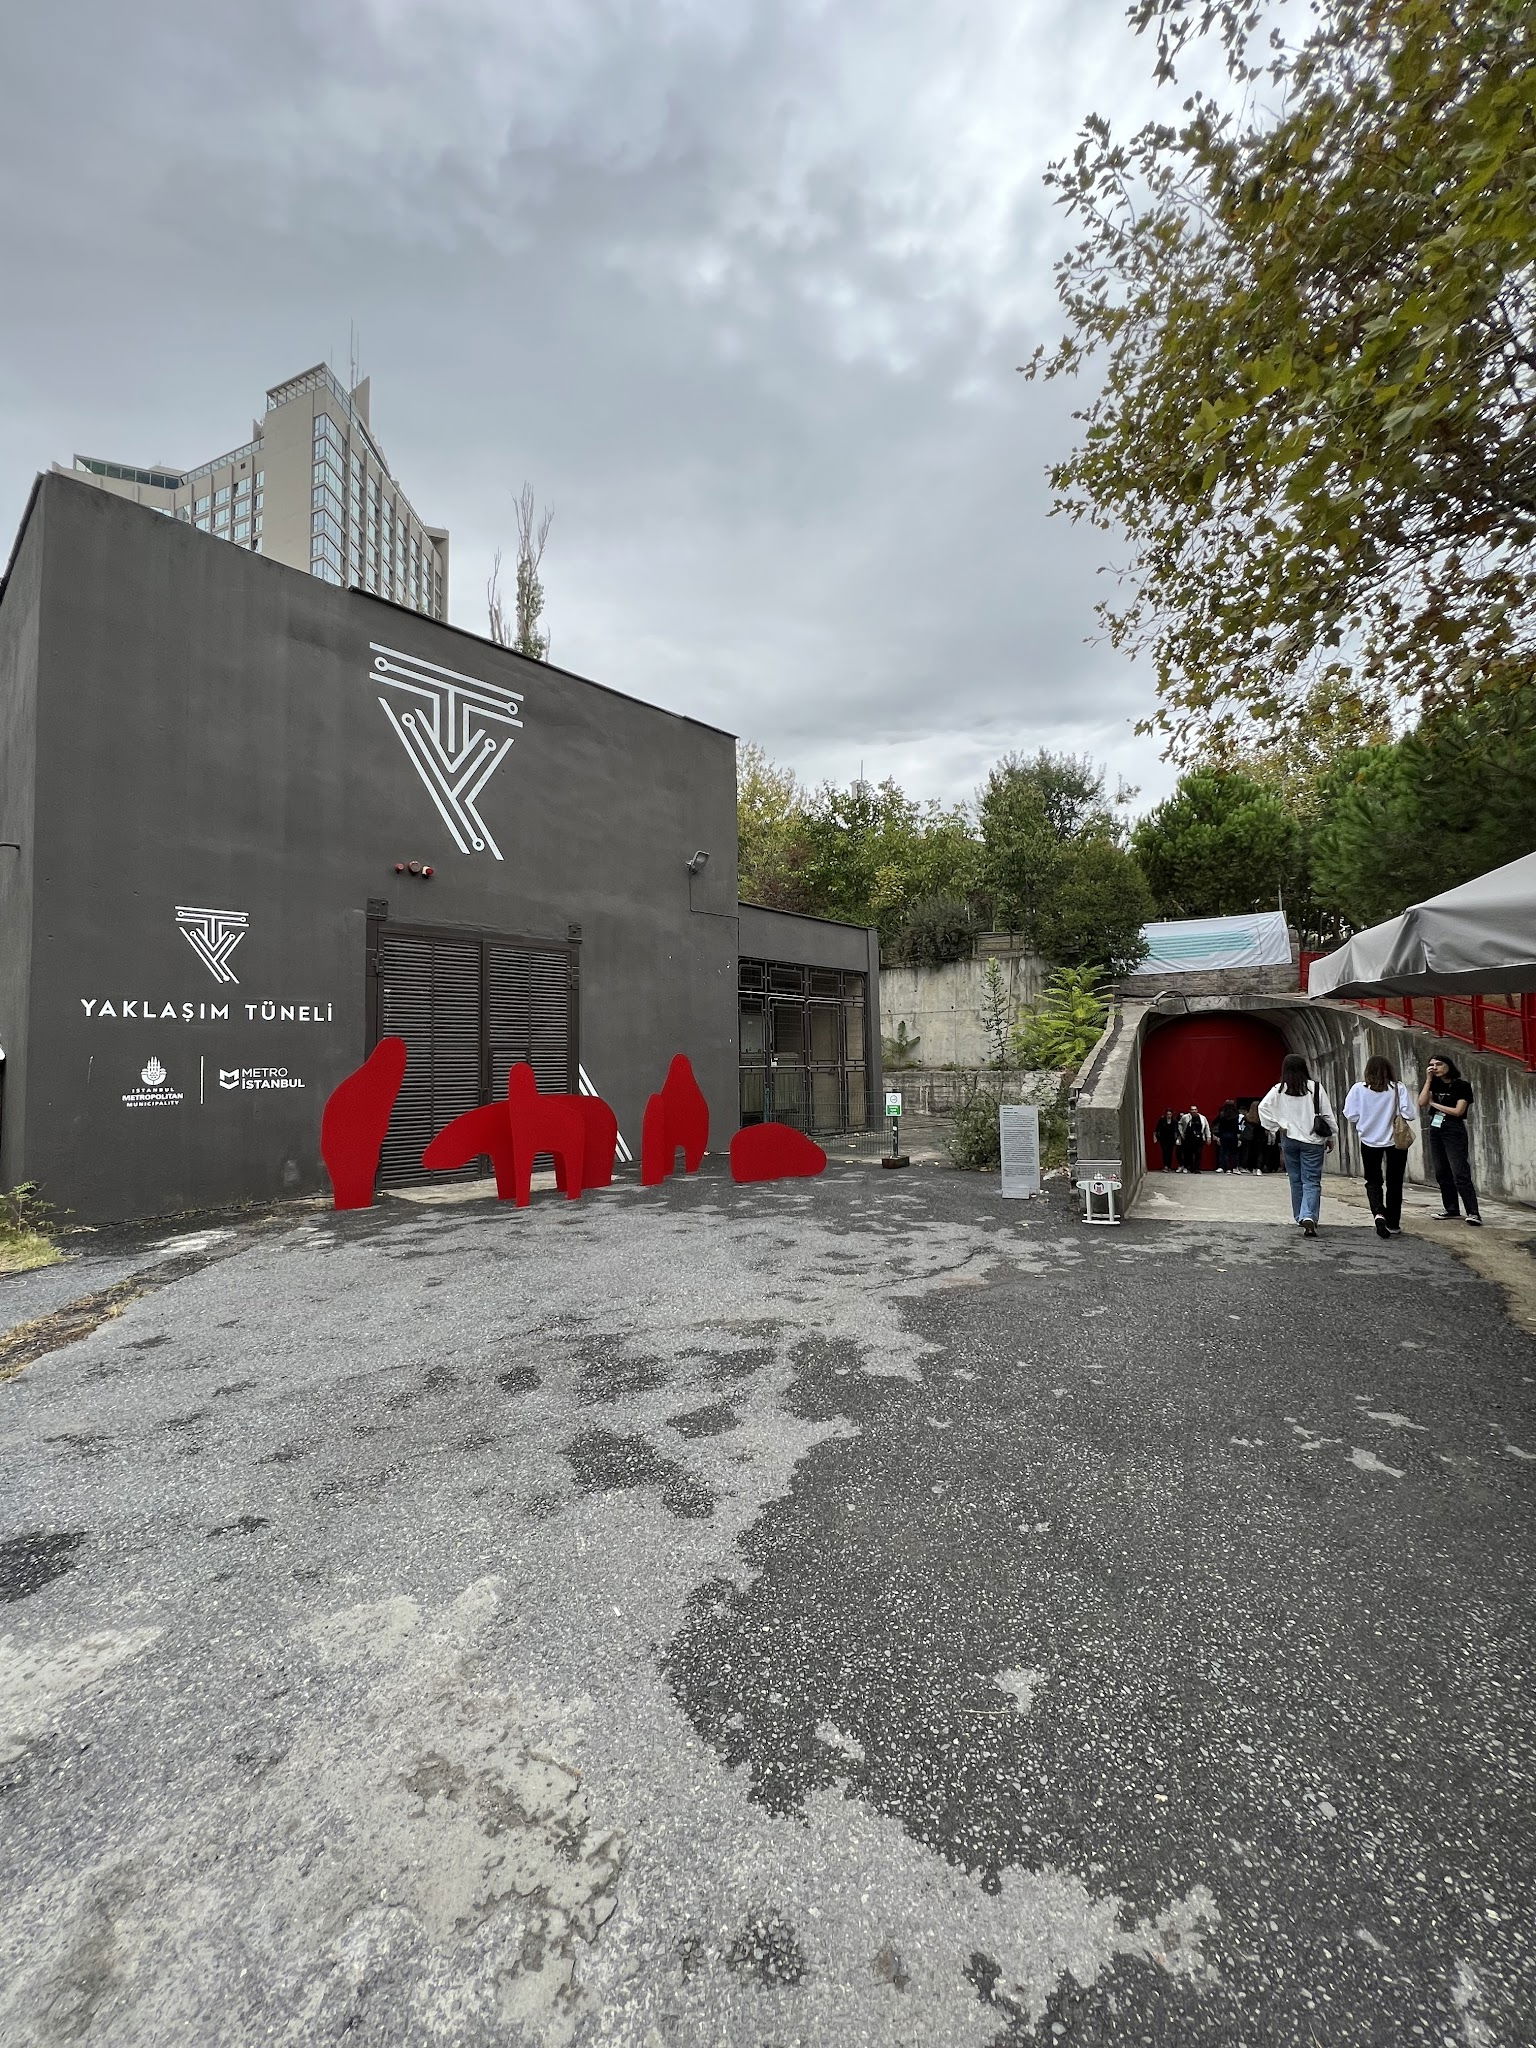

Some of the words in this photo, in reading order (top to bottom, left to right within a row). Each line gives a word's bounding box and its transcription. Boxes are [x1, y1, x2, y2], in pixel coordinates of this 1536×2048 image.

[80, 998, 229, 1022] YAKLAŞIM
[244, 1000, 333, 1022] TÜNELİ
[241, 1067, 288, 1078] METRO
[241, 1077, 305, 1090] İSTANBUL
[121, 1093, 184, 1102] METROPOLITAN
